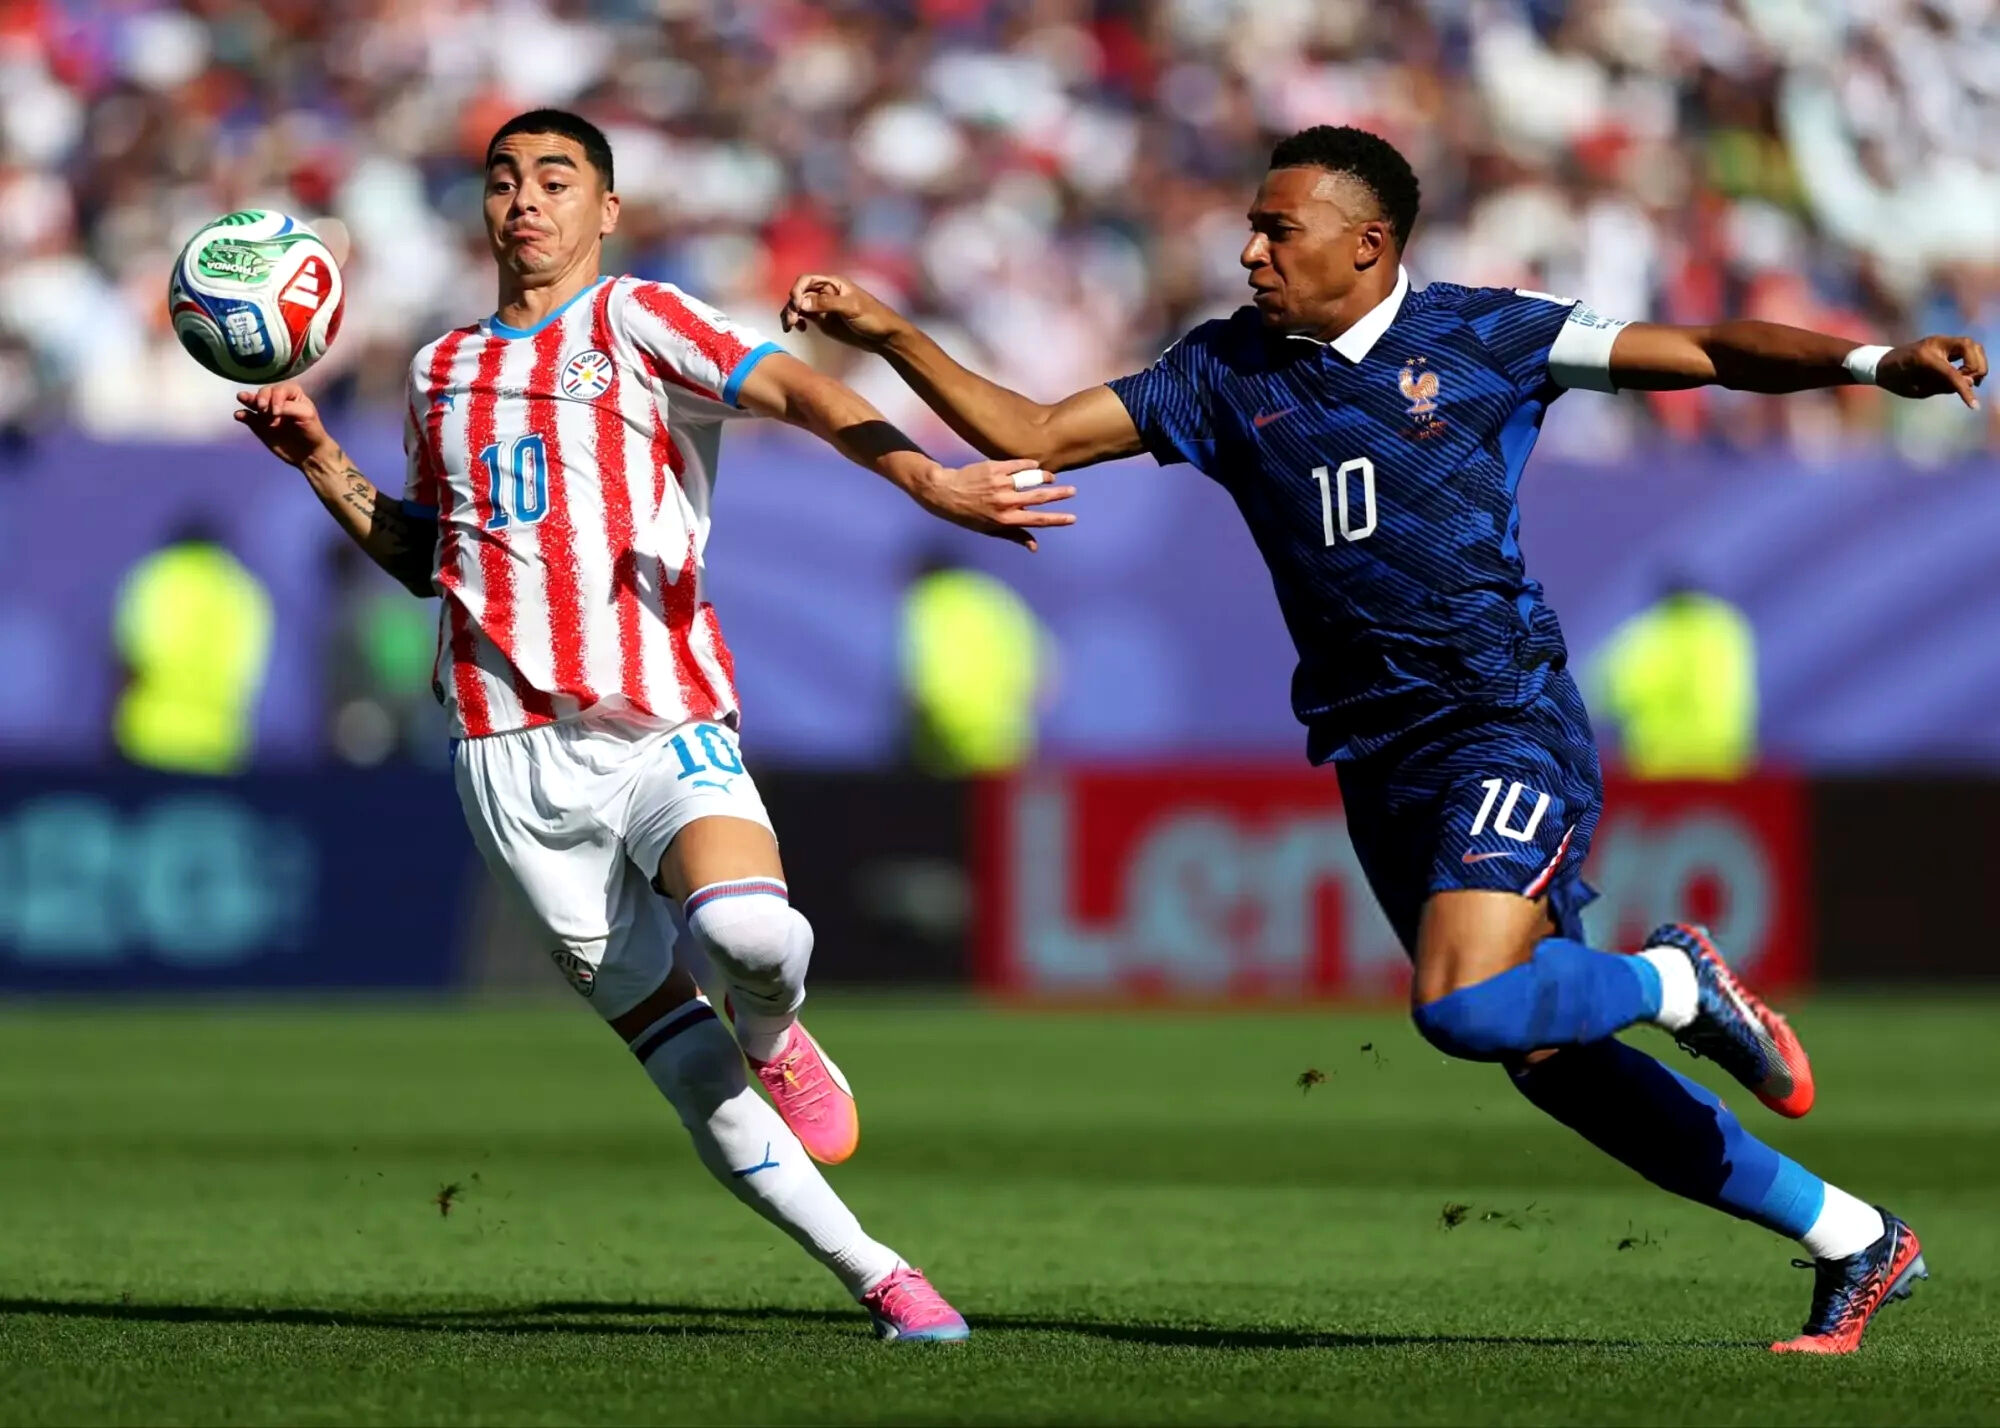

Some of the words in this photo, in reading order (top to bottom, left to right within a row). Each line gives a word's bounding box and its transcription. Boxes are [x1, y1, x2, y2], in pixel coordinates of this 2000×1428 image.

[206, 261, 258, 277] TRIONDA
[479, 432, 549, 530] 10
[1311, 457, 1377, 546] 10
[662, 723, 744, 781] 10
[1469, 778, 1550, 842] 10
